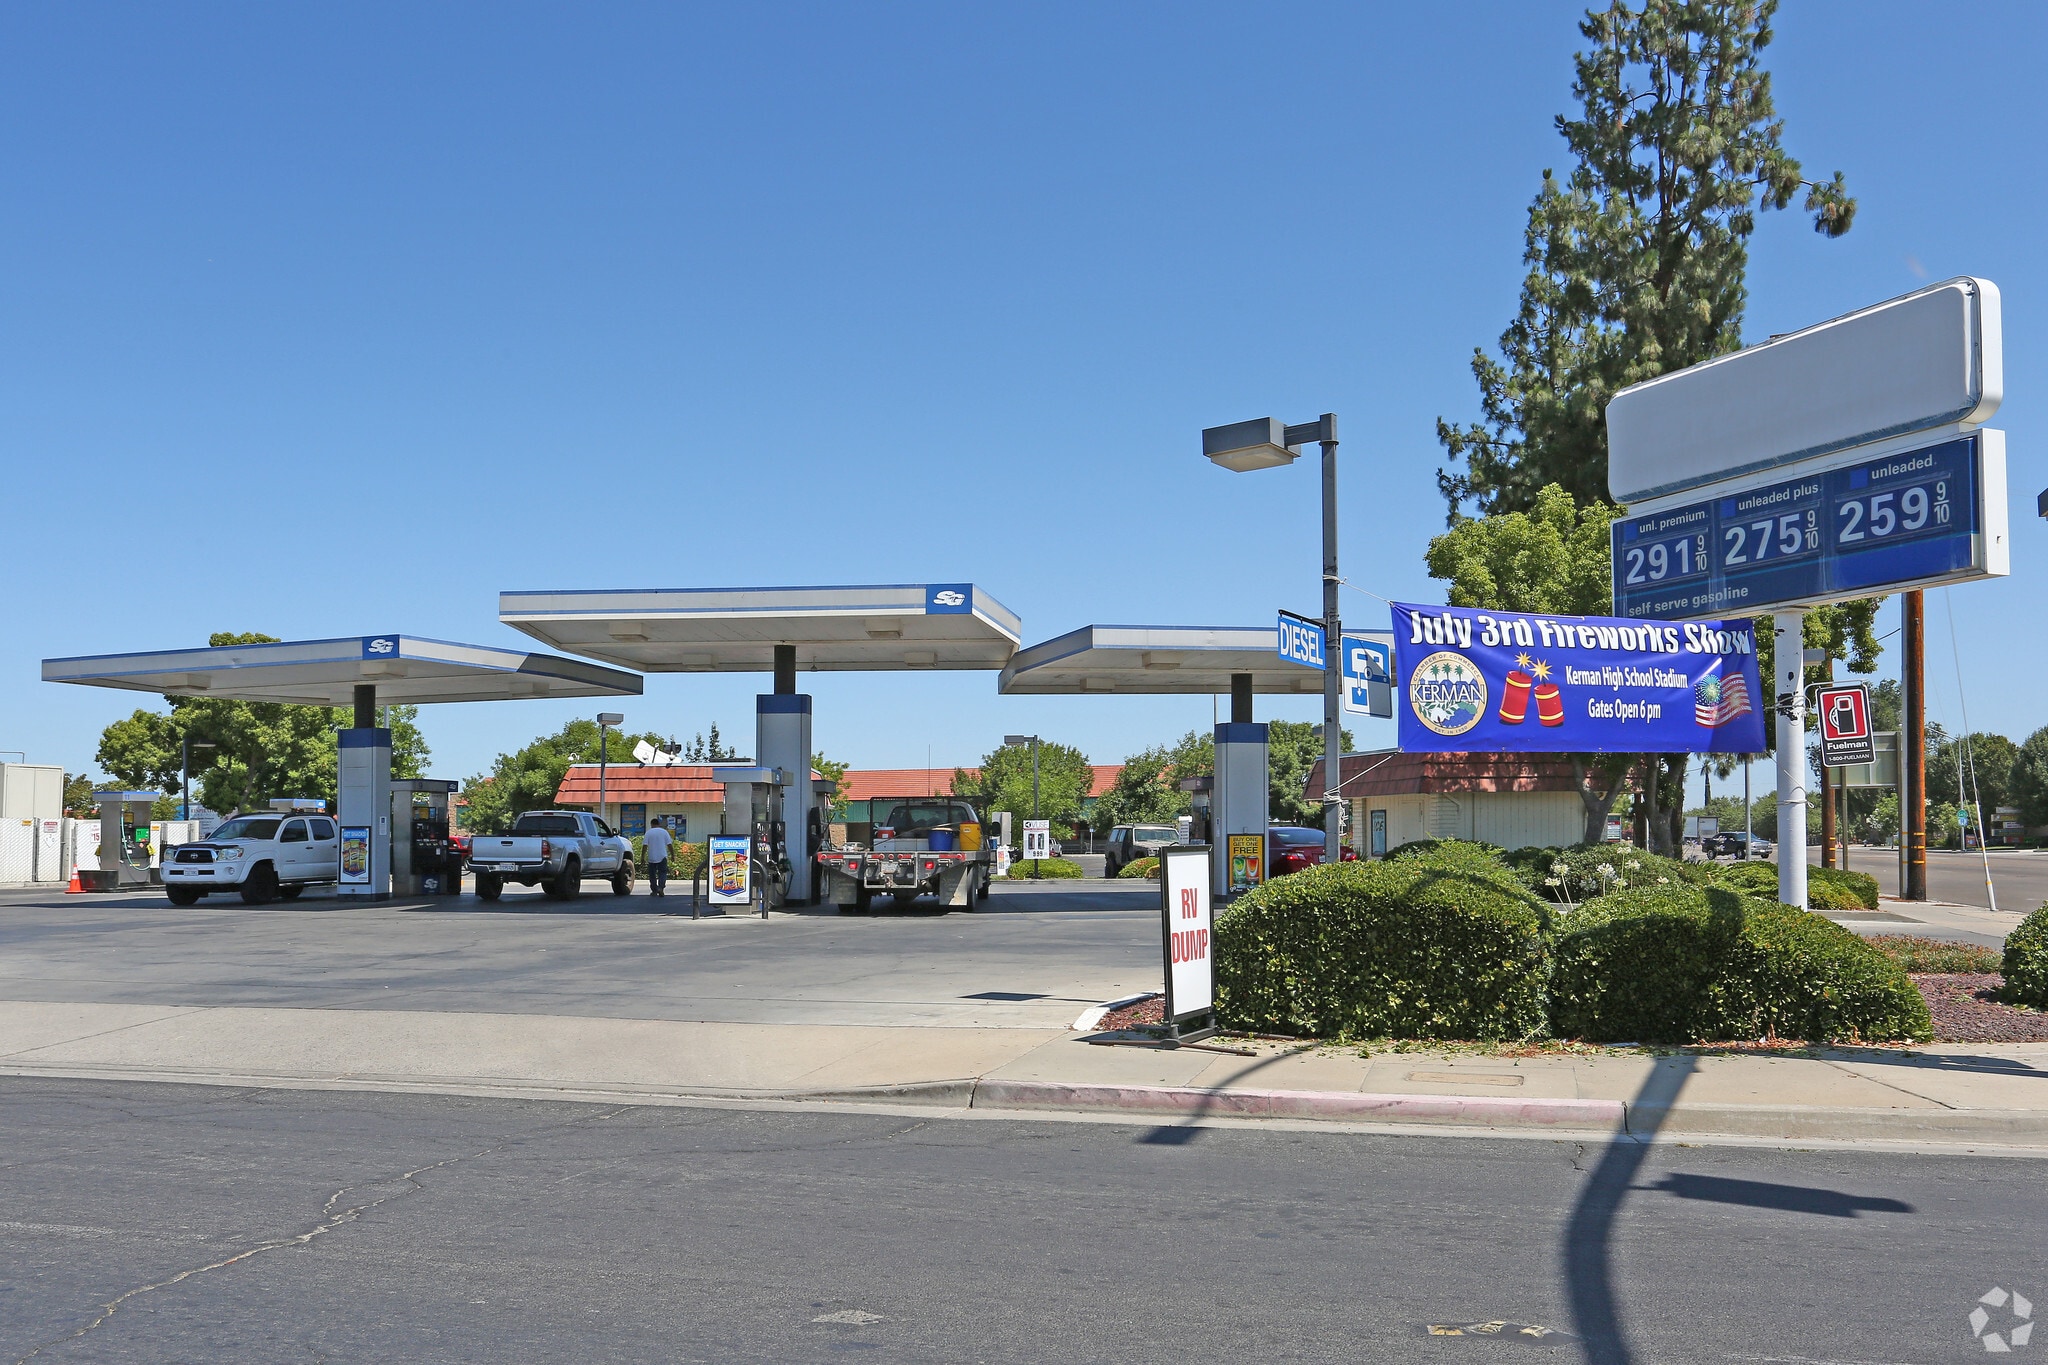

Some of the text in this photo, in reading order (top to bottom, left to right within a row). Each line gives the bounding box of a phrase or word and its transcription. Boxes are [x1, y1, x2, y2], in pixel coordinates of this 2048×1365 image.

[1872, 454, 1932, 480] unleaded
[1738, 482, 1818, 510] unleaded plus
[1640, 510, 1705, 533] unl. premium
[1839, 486, 1928, 543] 259
[1725, 514, 1802, 566] 275
[1626, 538, 1689, 584] 291
[933, 590, 966, 606] SG
[1628, 587, 1748, 617] self serve gasoline
[368, 638, 394, 654] SG
[1280, 620, 1324, 666] DIESEL
[1410, 610, 1750, 655] July 3rd Fireworks Show
[1414, 656, 1436, 682] CHAMBER
[1449, 654, 1480, 678] COMMERCE
[1565, 666, 1688, 692] Kerman High School Stadium
[1410, 684, 1485, 703] KERMAN
[1588, 698, 1660, 724] Gates Open 6 pm
[1826, 741, 1868, 750] Fuelman
[1828, 754, 1870, 762] 1-800-FUELMAN
[1234, 846, 1258, 854] FREE
[1180, 888, 1198, 919] RV
[1172, 928, 1208, 964] DUMP
